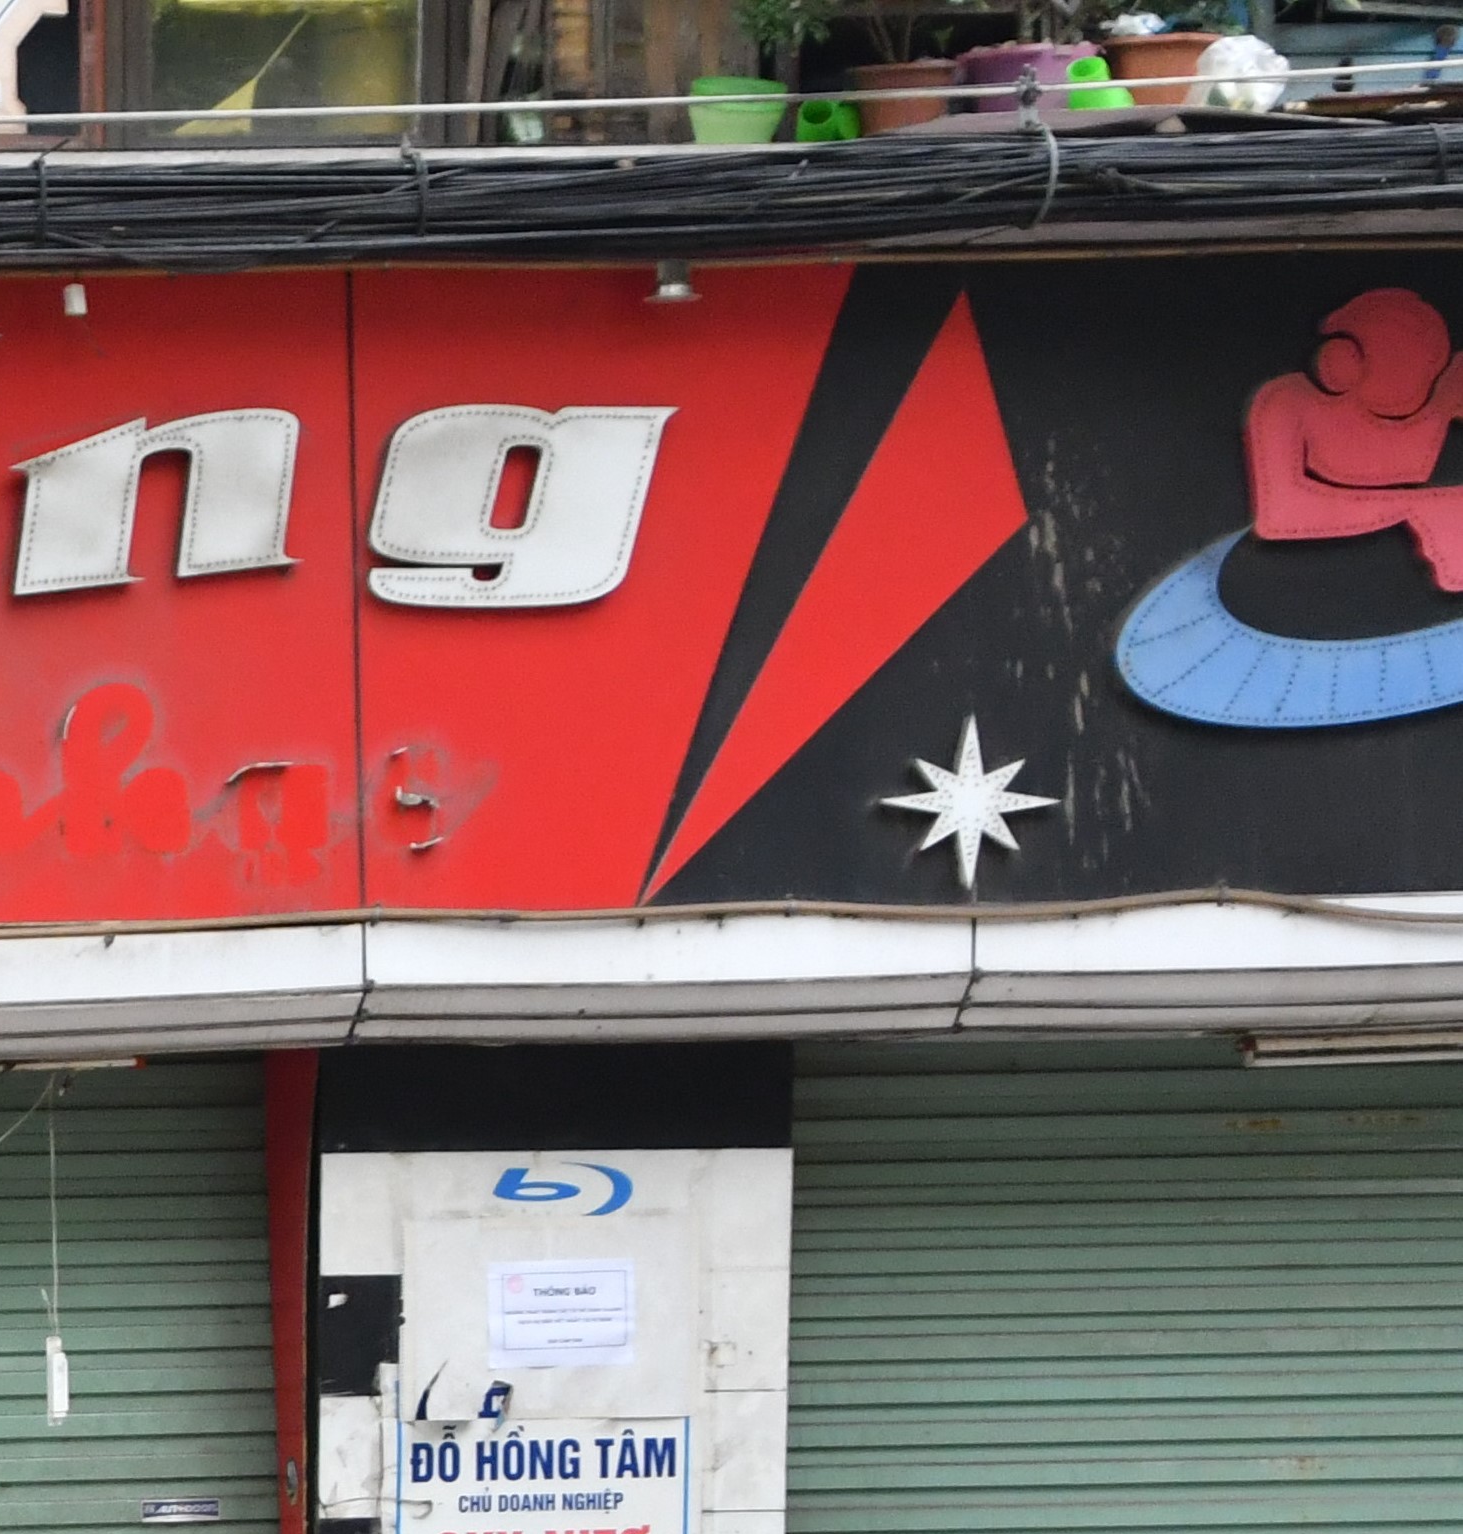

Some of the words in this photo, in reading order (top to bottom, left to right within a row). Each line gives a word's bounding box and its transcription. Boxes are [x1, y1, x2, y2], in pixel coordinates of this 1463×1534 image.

[410, 1425, 461, 1483] ĐỖ
[476, 1426, 581, 1481] HỒNG
[595, 1429, 677, 1478] TÂM
[458, 1487, 492, 1513] CHỦ
[498, 1493, 556, 1512] DOANH
[562, 1489, 624, 1515] NGHIỆP
